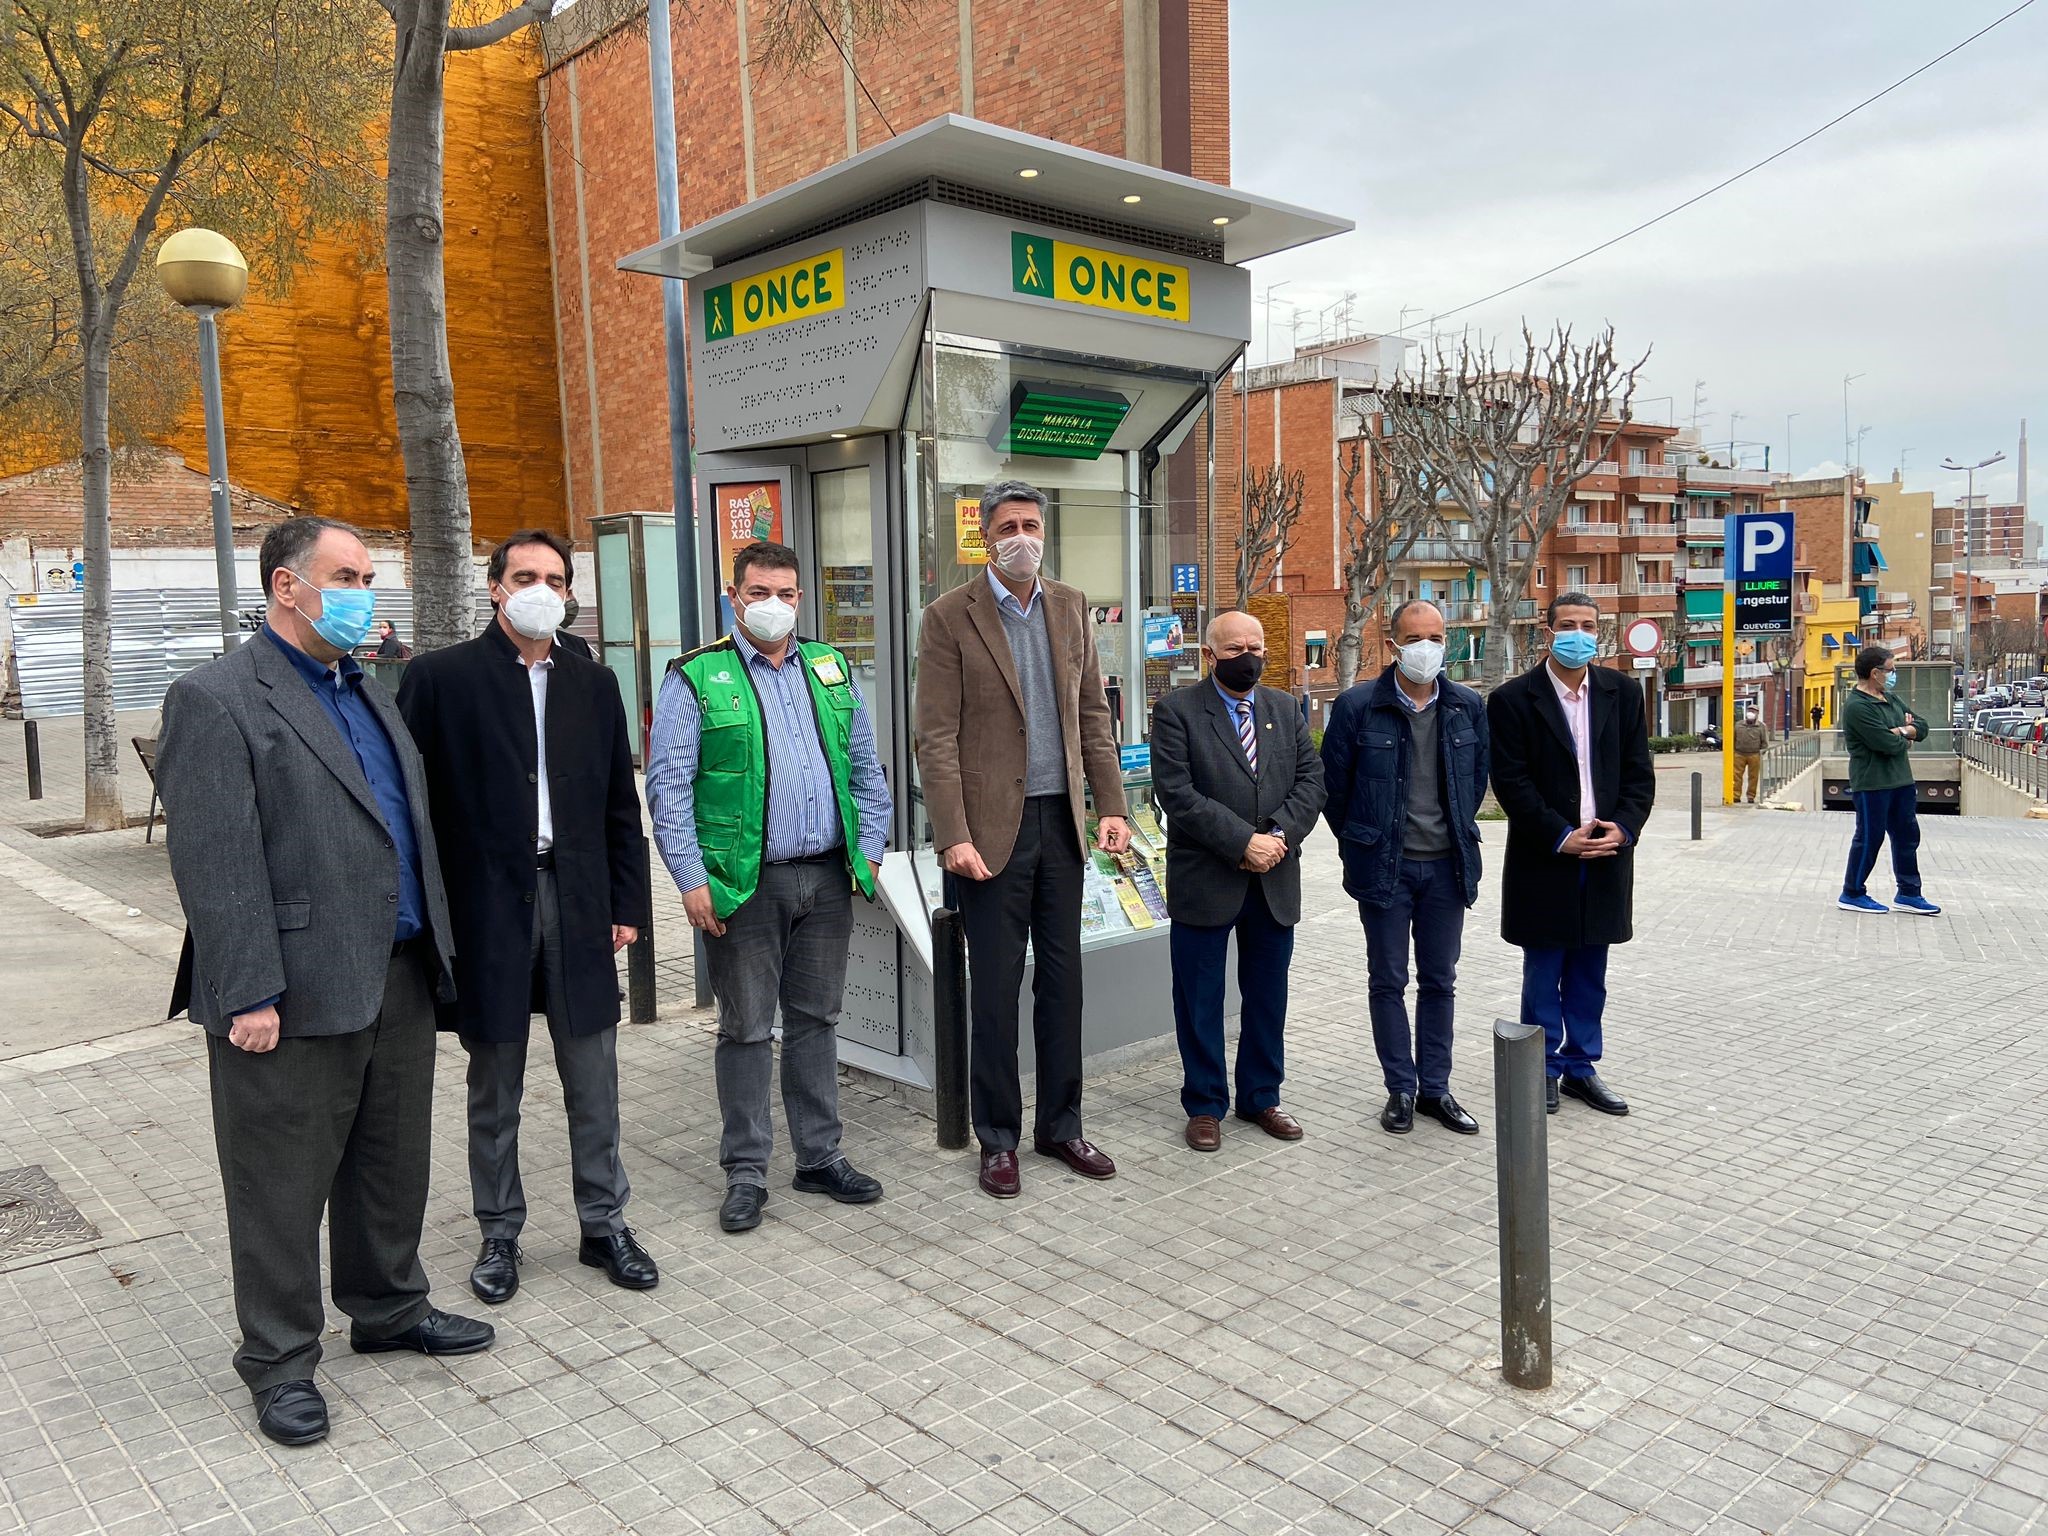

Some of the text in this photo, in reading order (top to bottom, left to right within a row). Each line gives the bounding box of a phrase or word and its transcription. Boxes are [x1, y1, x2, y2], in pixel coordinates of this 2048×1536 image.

[1069, 255, 1176, 312] ONCE
[743, 261, 832, 322] ONCE
[1041, 414, 1092, 430] MANTÉN LA
[1065, 432, 1097, 446] SOCIAL
[729, 498, 750, 509] RAS
[730, 508, 751, 519] CAS
[730, 518, 751, 530] X10
[731, 529, 752, 540] X20
[1743, 521, 1786, 573] P
[1736, 595, 1789, 607] engestur
